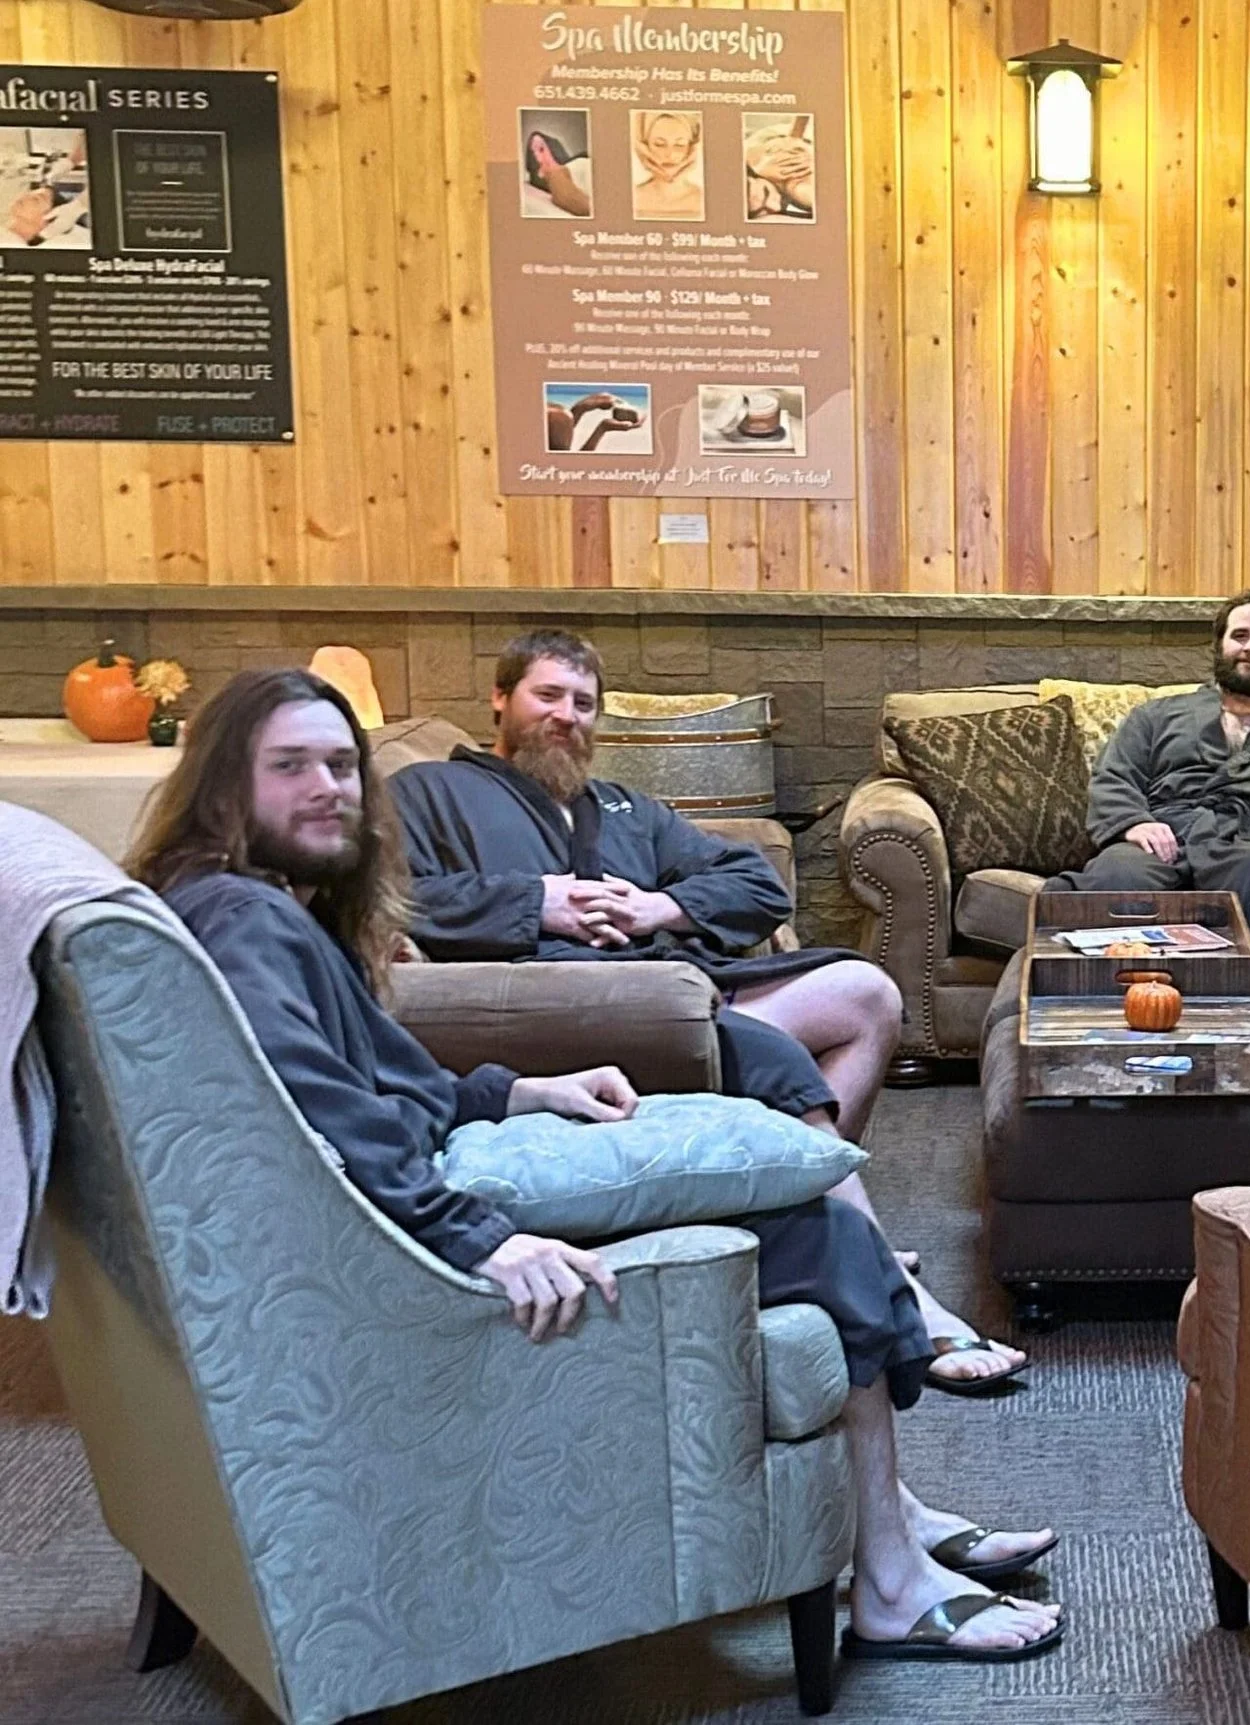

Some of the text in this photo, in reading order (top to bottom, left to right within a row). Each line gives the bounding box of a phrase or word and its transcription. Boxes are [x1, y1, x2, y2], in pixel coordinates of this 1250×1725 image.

[541, 11, 784, 65] Spa Membership
[551, 63, 649, 83] Membership
[651, 67, 683, 81] Has
[0, 76, 210, 121] facial SERIES
[572, 230, 596, 247] Spa
[572, 287, 595, 304] Spa
[51, 361, 81, 378] FOR
[82, 361, 110, 379] THE
[112, 362, 147, 379] BEST
[183, 363, 202, 380] OF
[203, 364, 242, 380] YOUR
[243, 364, 273, 381] LIFE
